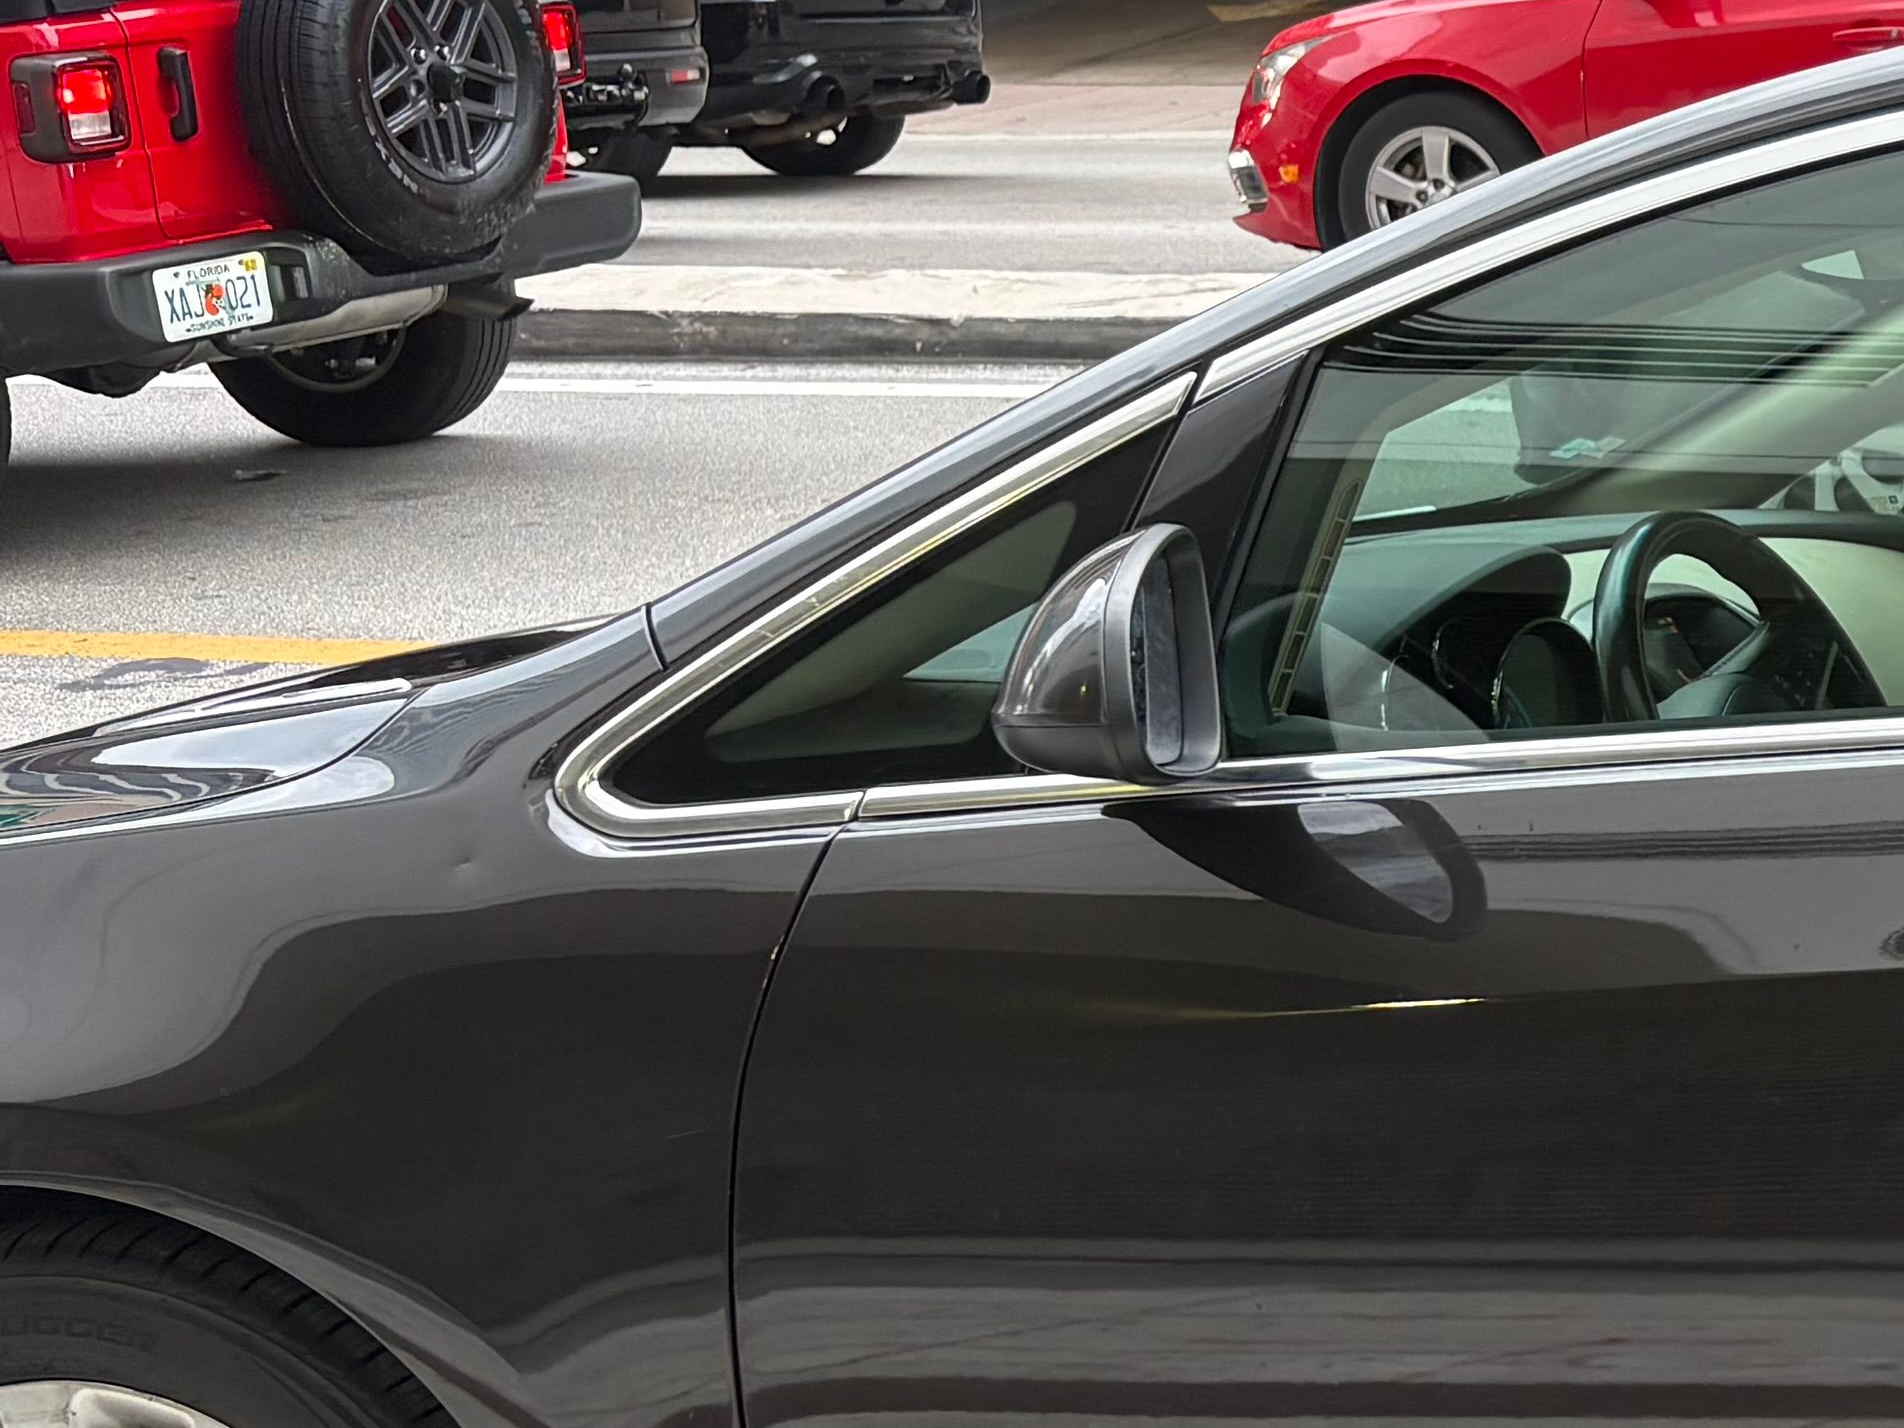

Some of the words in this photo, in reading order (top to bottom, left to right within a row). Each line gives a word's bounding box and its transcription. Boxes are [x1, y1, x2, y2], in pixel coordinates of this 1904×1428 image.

[187, 264, 231, 280] FLORIDA
[165, 281, 206, 324] XAJ
[225, 274, 261, 312] 021
